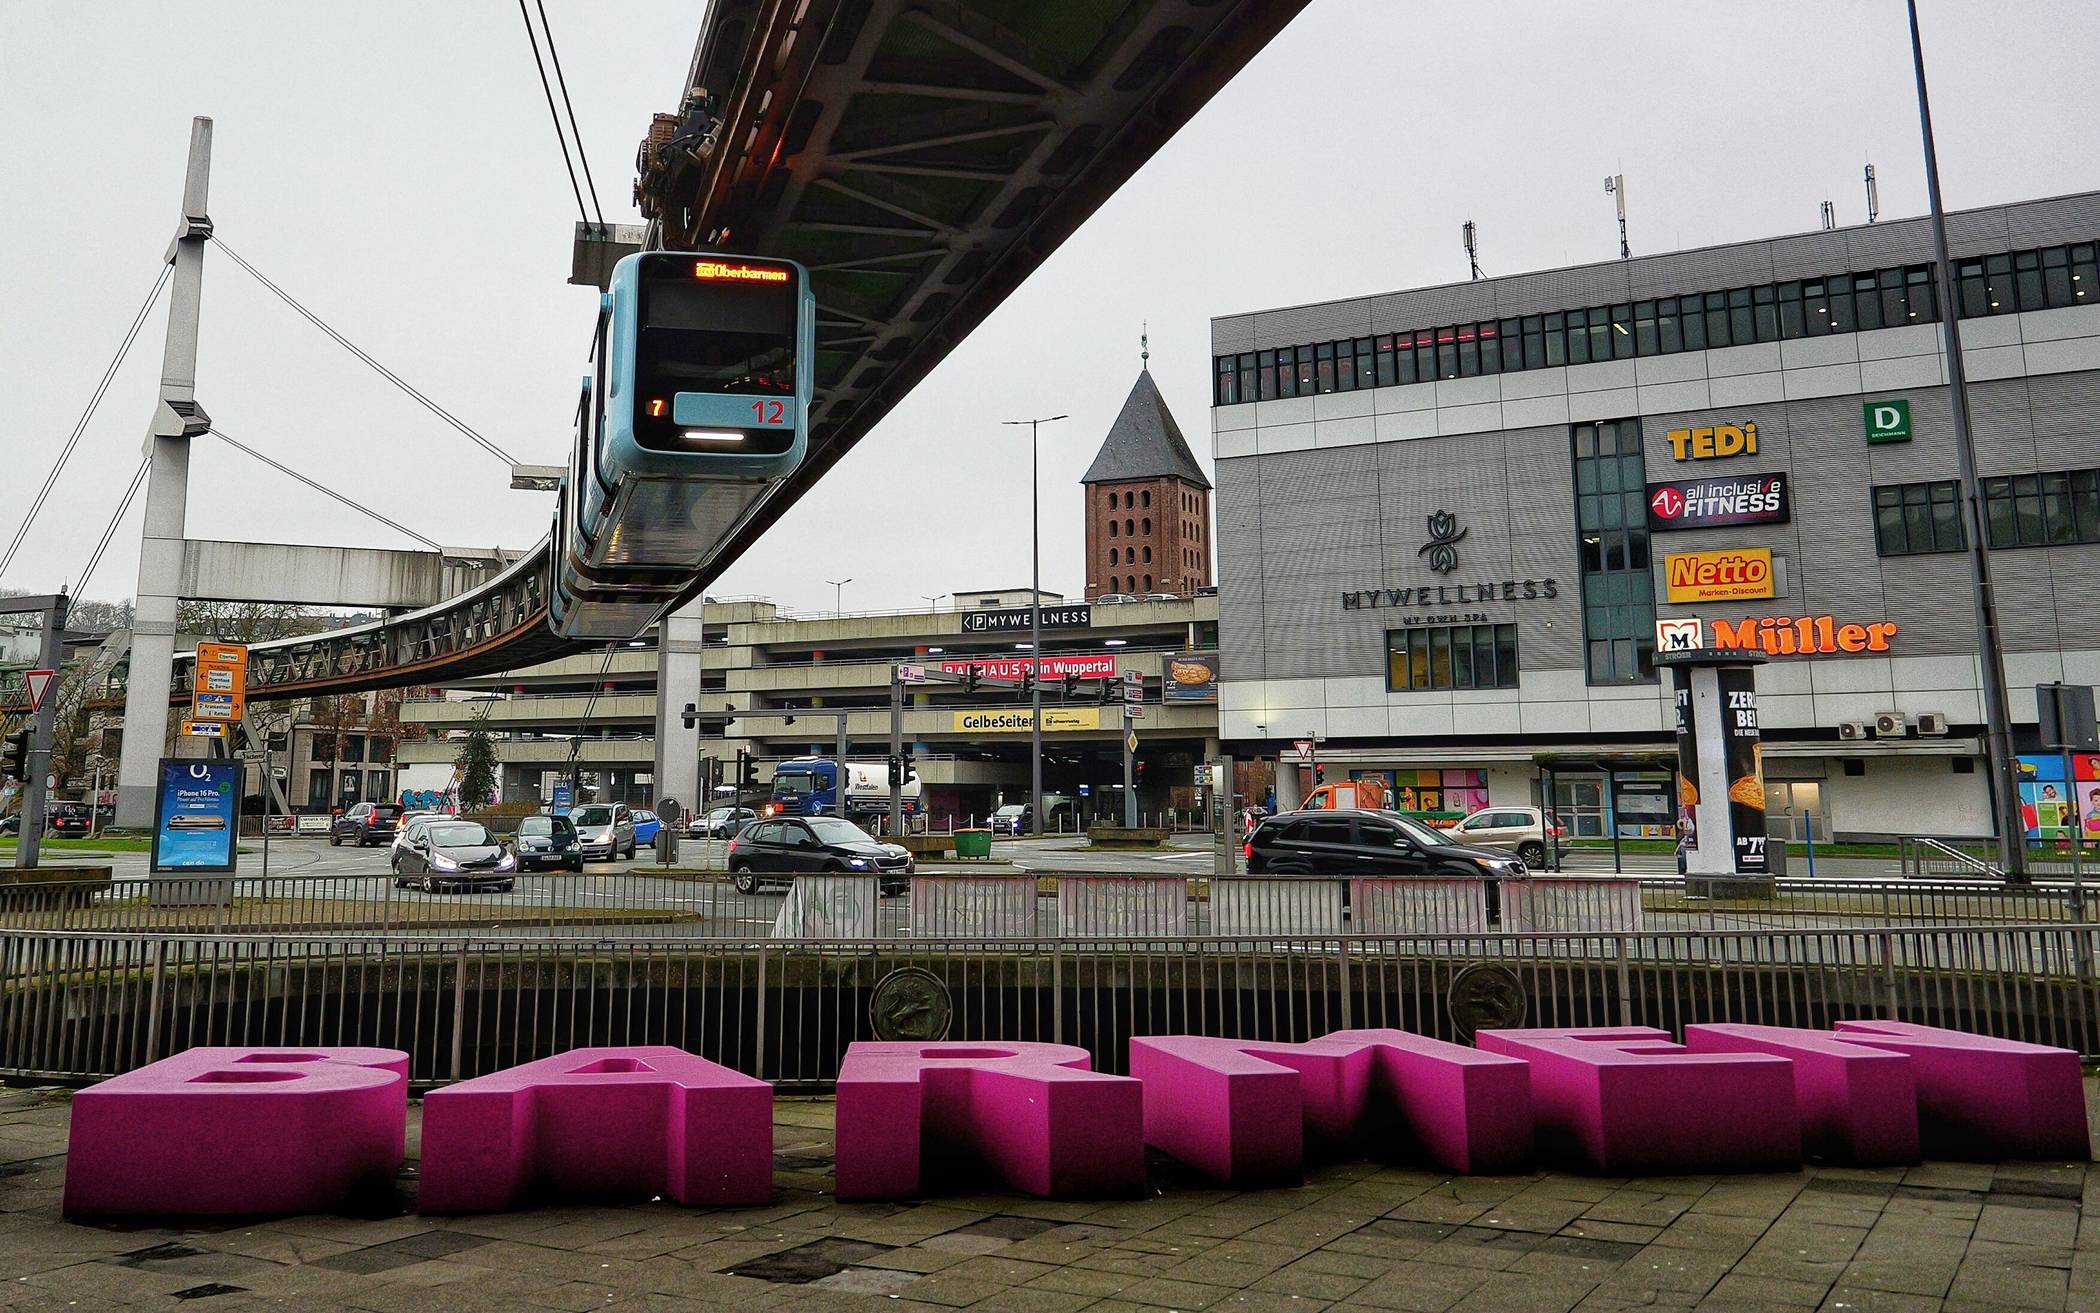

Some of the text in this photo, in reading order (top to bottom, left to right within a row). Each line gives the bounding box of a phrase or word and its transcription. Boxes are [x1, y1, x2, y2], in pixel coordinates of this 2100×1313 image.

[652, 399, 663, 417] 7
[751, 399, 785, 424] 12
[1874, 406, 1901, 430] D
[1666, 422, 1758, 461] TEDi
[1686, 485, 1707, 499] all
[1683, 493, 1780, 518] FITNESS
[1671, 556, 1767, 587] Netto
[1341, 577, 1559, 611] MYWELLNESS
[1698, 586, 1767, 598] Marken-Discount
[988, 611, 1088, 627] MYWELNESS
[1711, 615, 1898, 655] Müller
[1040, 662, 1050, 674] in
[1053, 659, 1113, 676] Wuppertal
[177, 789, 199, 797] iPhone
[199, 789, 207, 797] 16
[1736, 836, 1748, 846] AB
